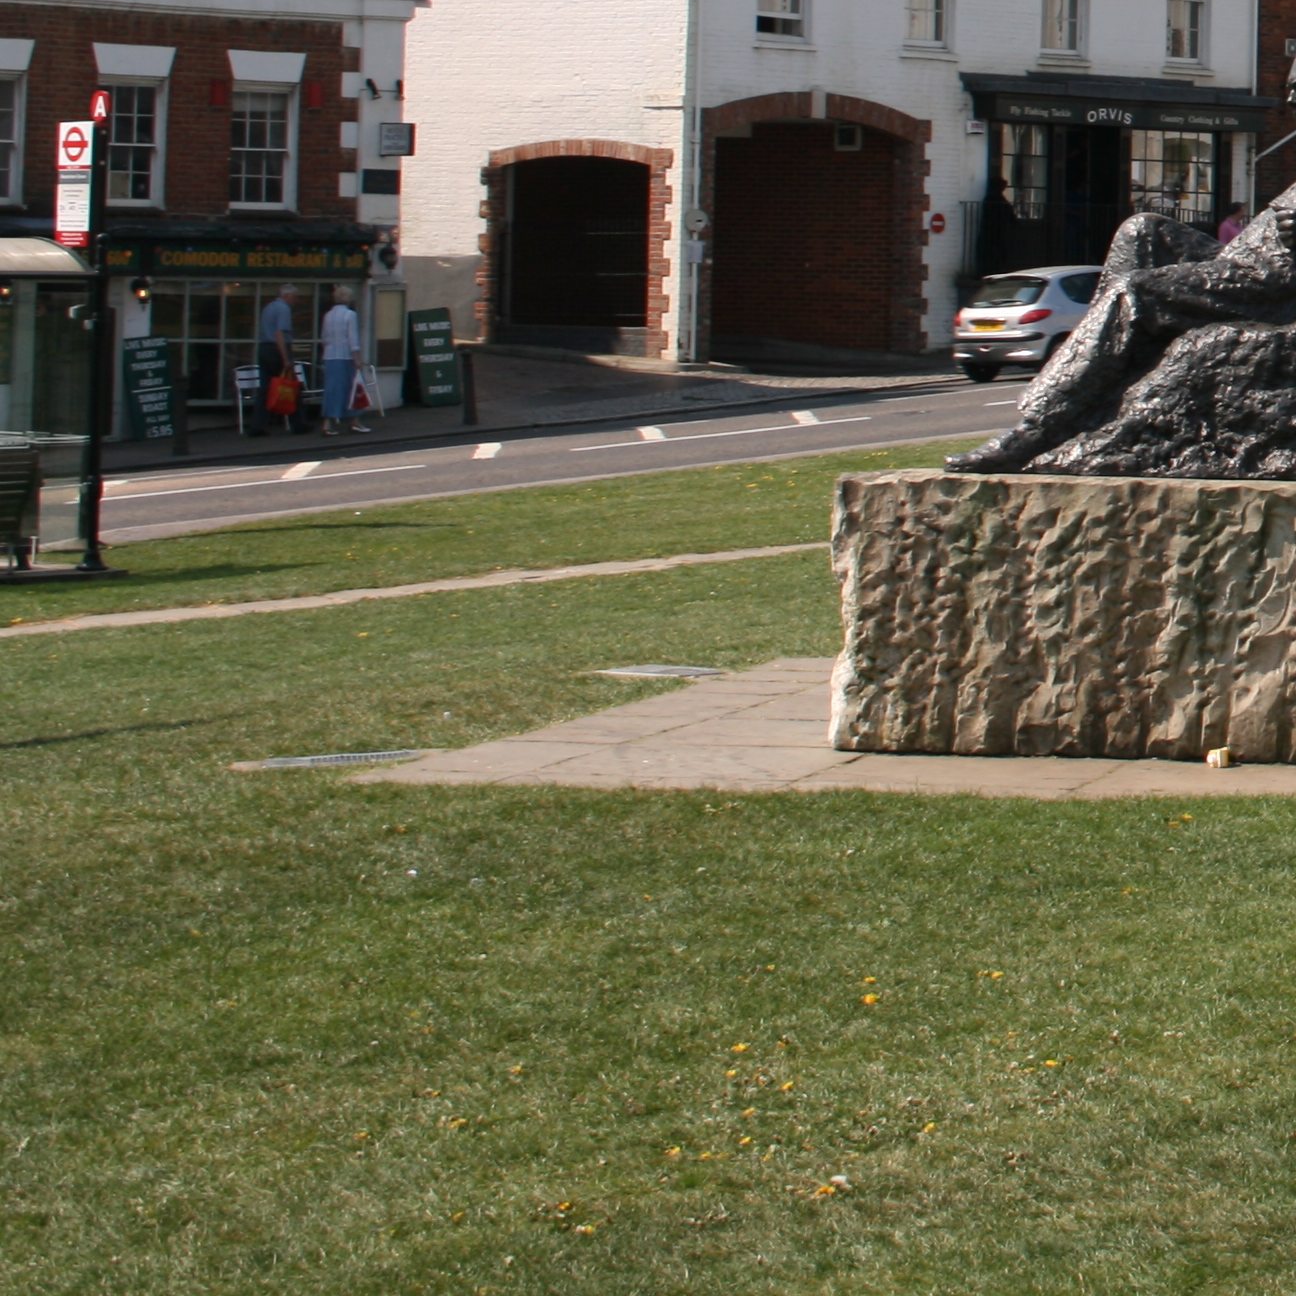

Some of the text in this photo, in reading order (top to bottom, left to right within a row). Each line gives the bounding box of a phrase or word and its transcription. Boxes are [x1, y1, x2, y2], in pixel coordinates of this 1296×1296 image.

[93, 95, 107, 118] A
[1010, 105, 1072, 118] Fly Fishing Tackle
[1087, 107, 1133, 125] ORVIS
[1160, 114, 1184, 125] Country
[1188, 114, 1213, 126] Clothing
[1223, 116, 1239, 126] Gifts
[160, 250, 240, 268] COMODOR
[246, 251, 328, 269] RESTAURANT
